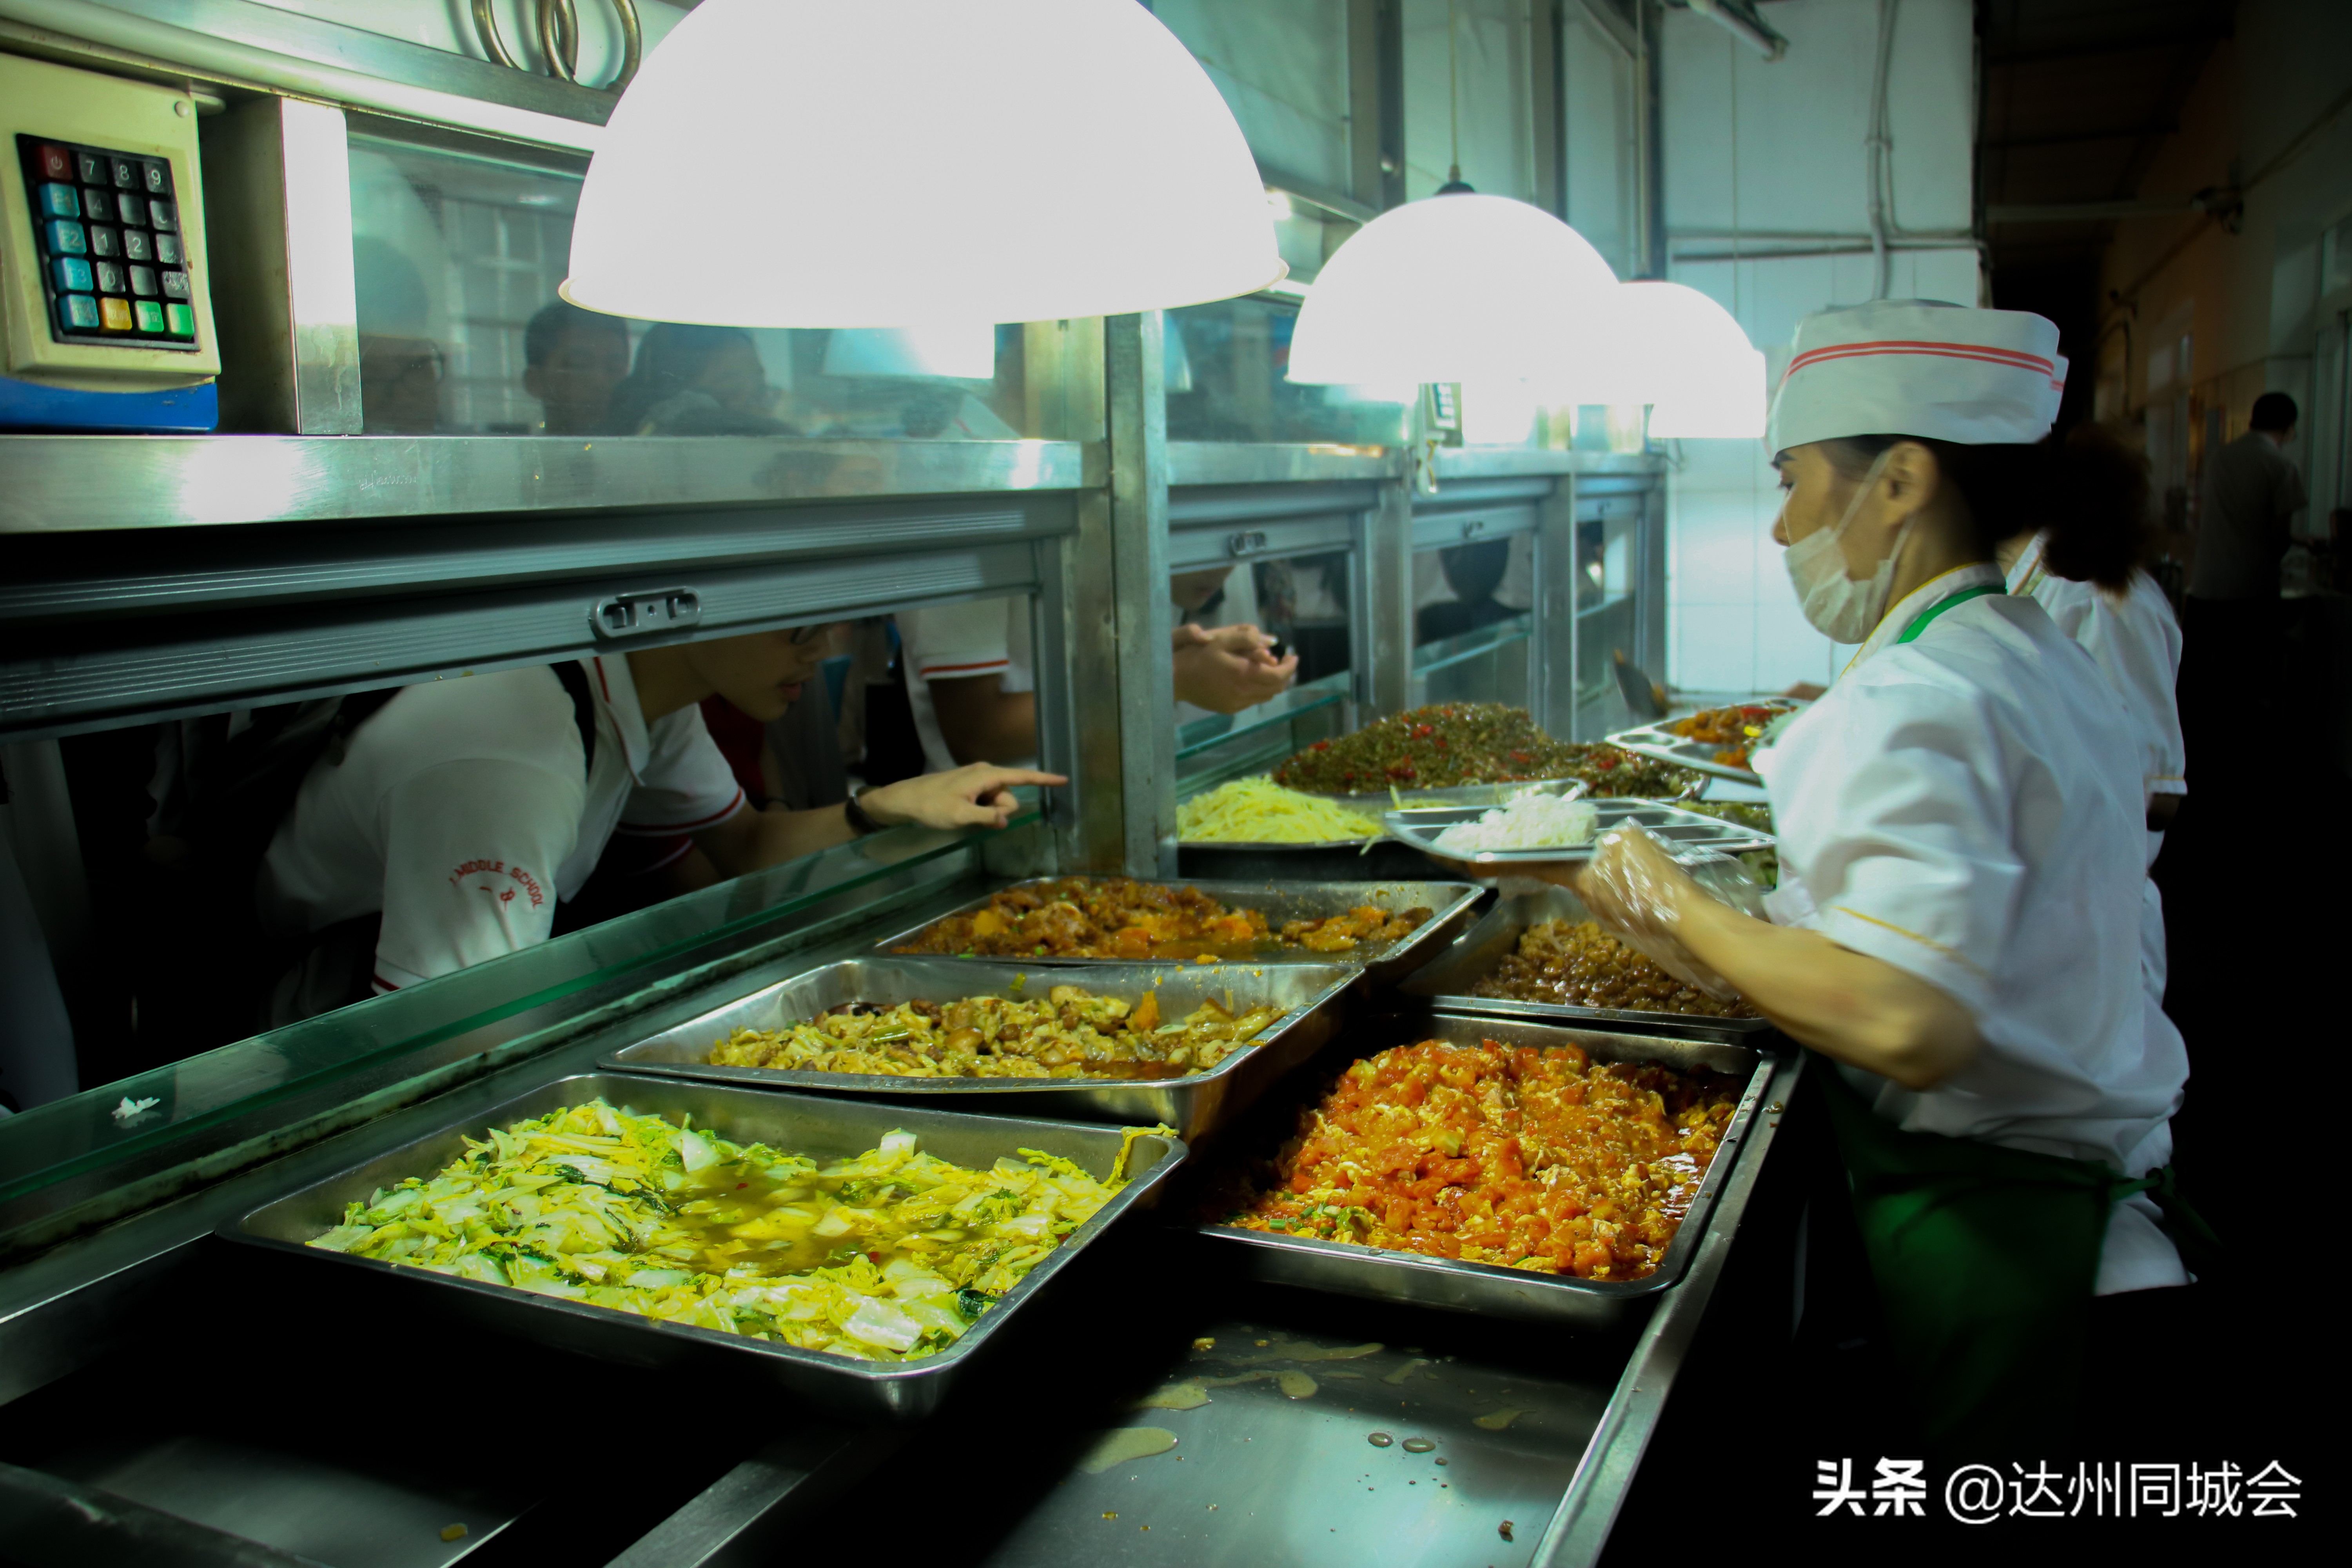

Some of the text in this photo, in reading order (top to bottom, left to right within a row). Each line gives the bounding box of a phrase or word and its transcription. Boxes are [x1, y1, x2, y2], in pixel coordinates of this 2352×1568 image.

[86, 160, 94, 176] 7
[120, 165, 129, 181] 8
[152, 169, 161, 185] 9
[101, 233, 108, 249] 1
[132, 237, 143, 253] 2
[107, 271, 116, 287] 0
[510, 867, 544, 910] SCHOOL
